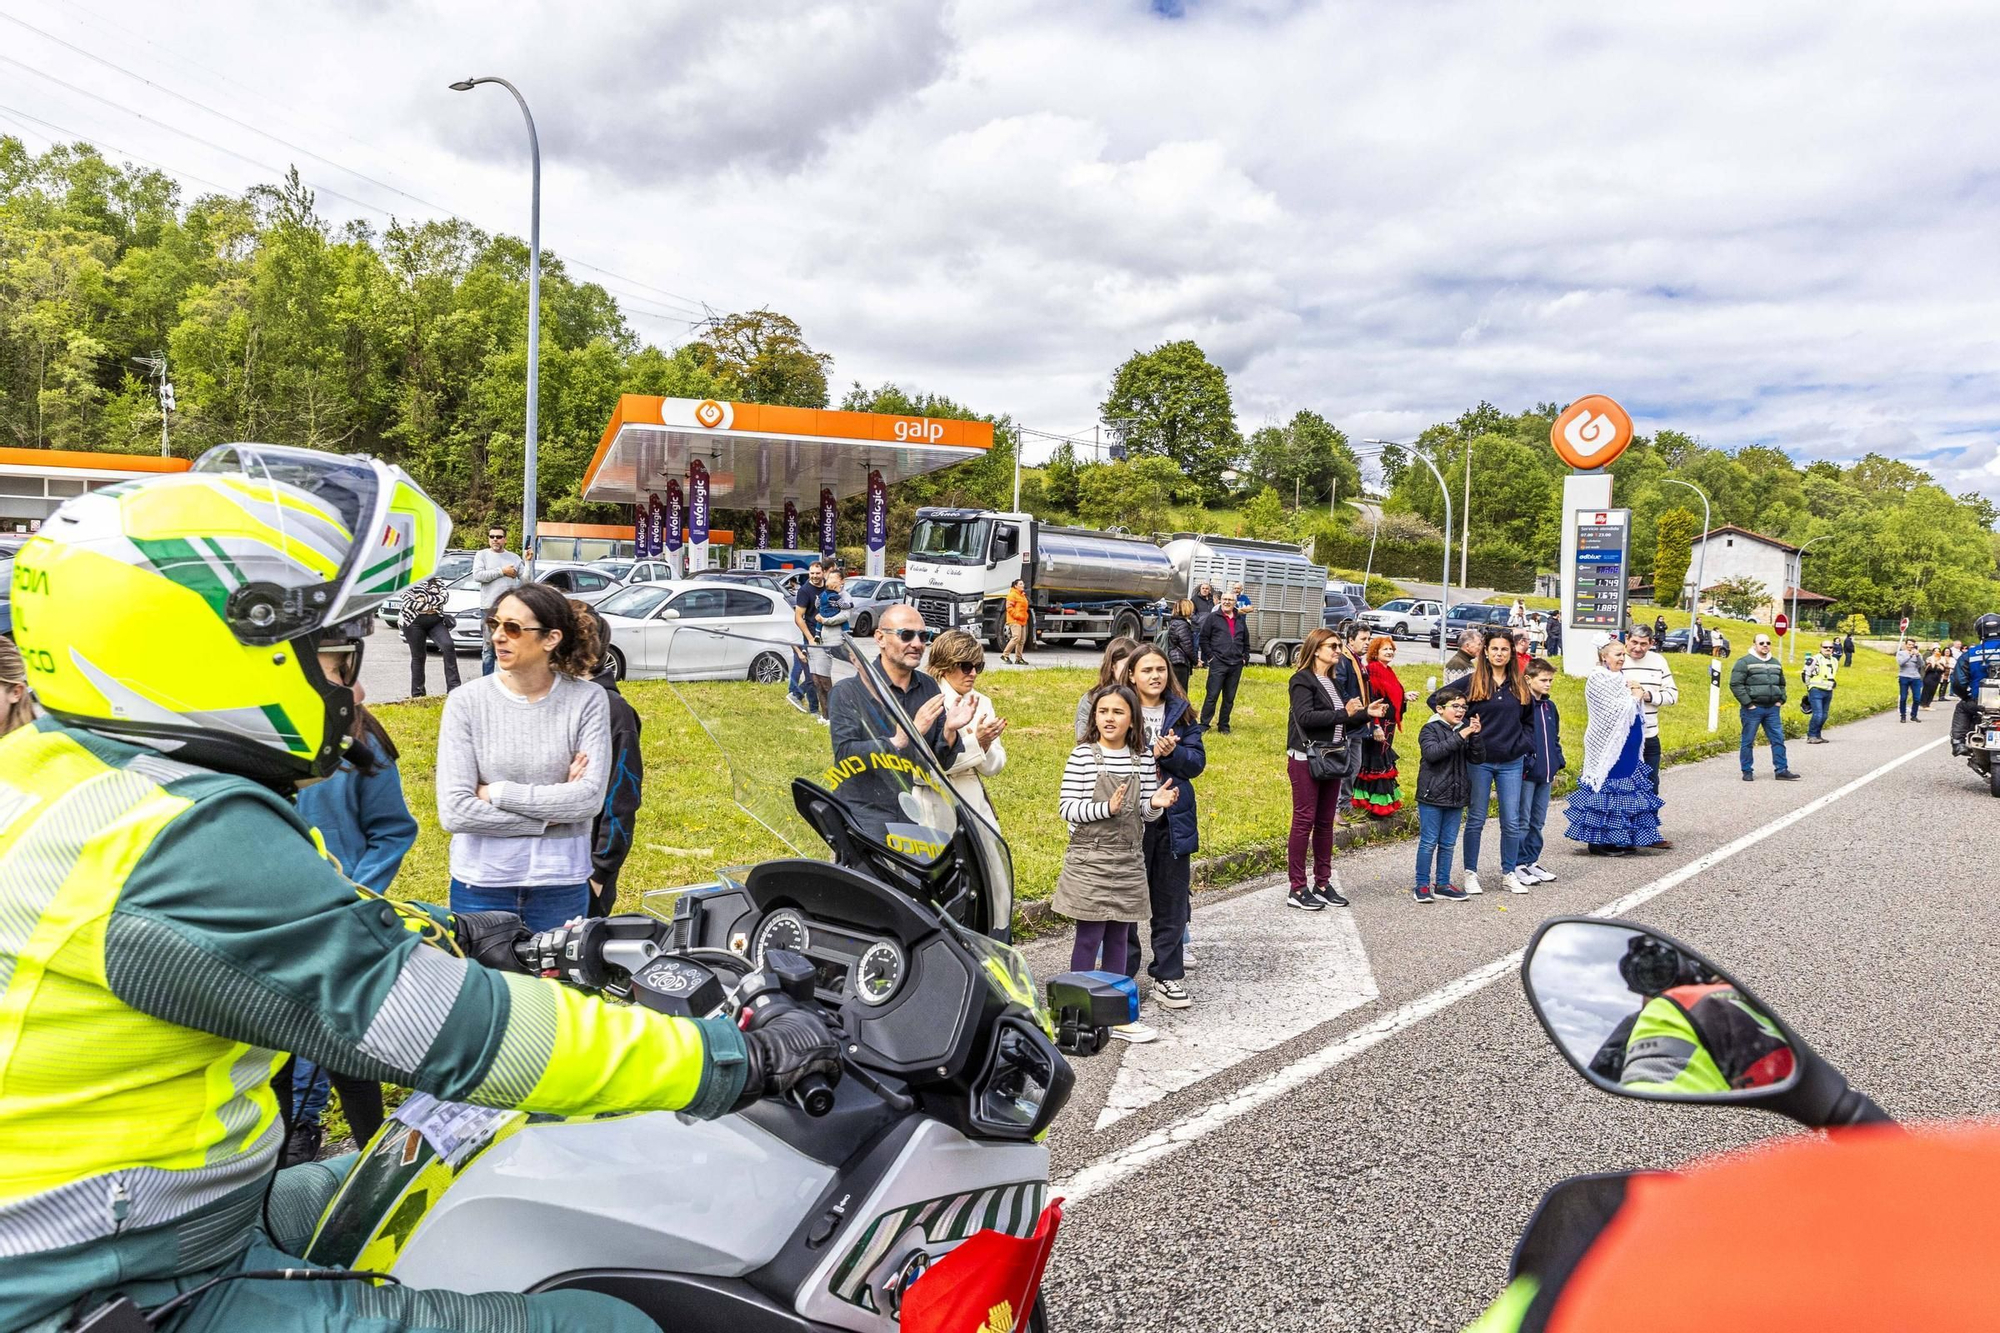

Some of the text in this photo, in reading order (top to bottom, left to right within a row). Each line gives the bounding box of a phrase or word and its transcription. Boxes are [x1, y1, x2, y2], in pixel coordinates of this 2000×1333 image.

[894, 418, 944, 443] galp
[670, 496, 681, 536] evologic
[694, 480, 707, 526] evologic
[873, 489, 884, 534] evologic
[637, 517, 647, 548] evologic
[651, 508, 662, 543] evologic
[824, 504, 834, 543] evologic
[1597, 591, 1619, 599] 1.679
[1598, 579, 1619, 587] 1.749
[1596, 604, 1618, 612] 1.889
